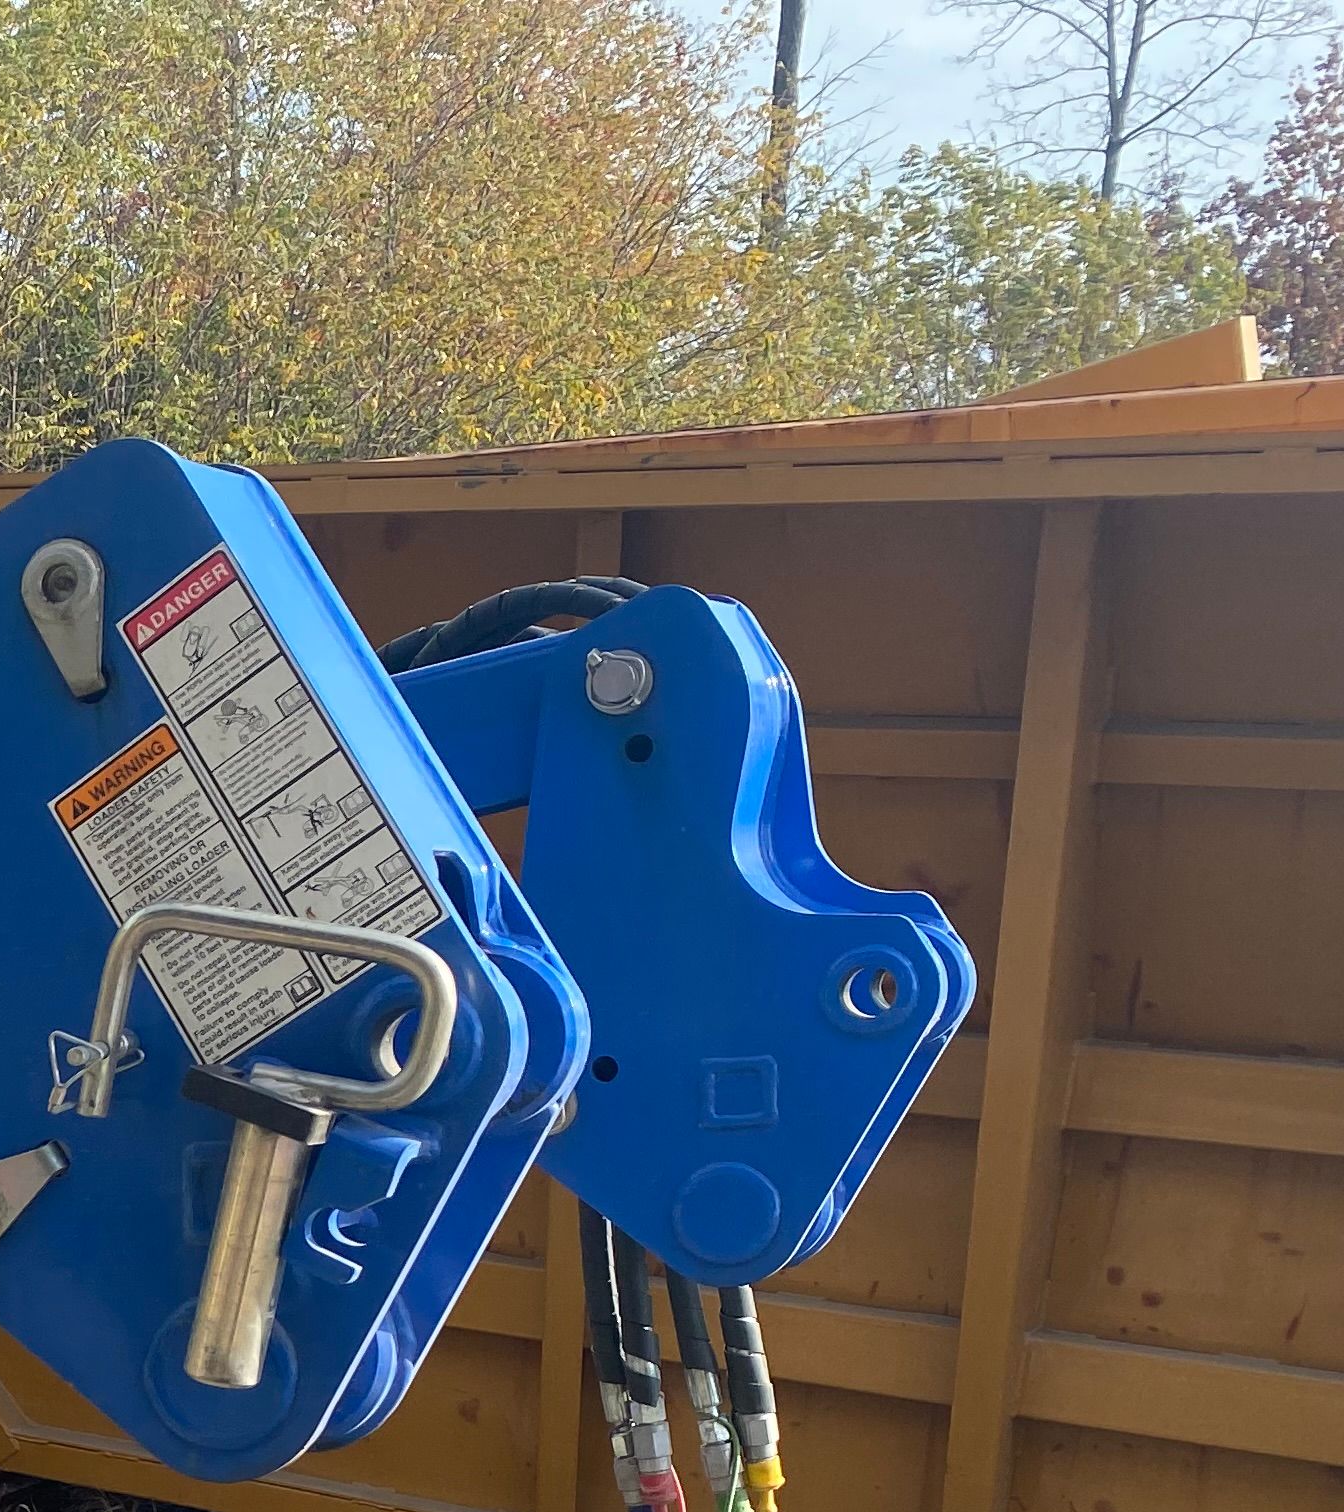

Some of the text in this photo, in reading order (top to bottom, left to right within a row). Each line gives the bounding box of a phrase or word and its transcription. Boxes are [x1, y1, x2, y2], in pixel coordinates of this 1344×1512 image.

[149, 560, 229, 630] DANGER
[86, 764, 170, 831] LOADER SAFETY
[88, 738, 165, 802] WARNING
[124, 870, 184, 917] INSTALLING
[184, 839, 230, 875] LOADER
[132, 838, 206, 895] REMOVING OR
[193, 984, 269, 1039] Failure to comply
[198, 1028, 223, 1048] could
[203, 1046, 215, 1057] or
[214, 1024, 249, 1050] serious
